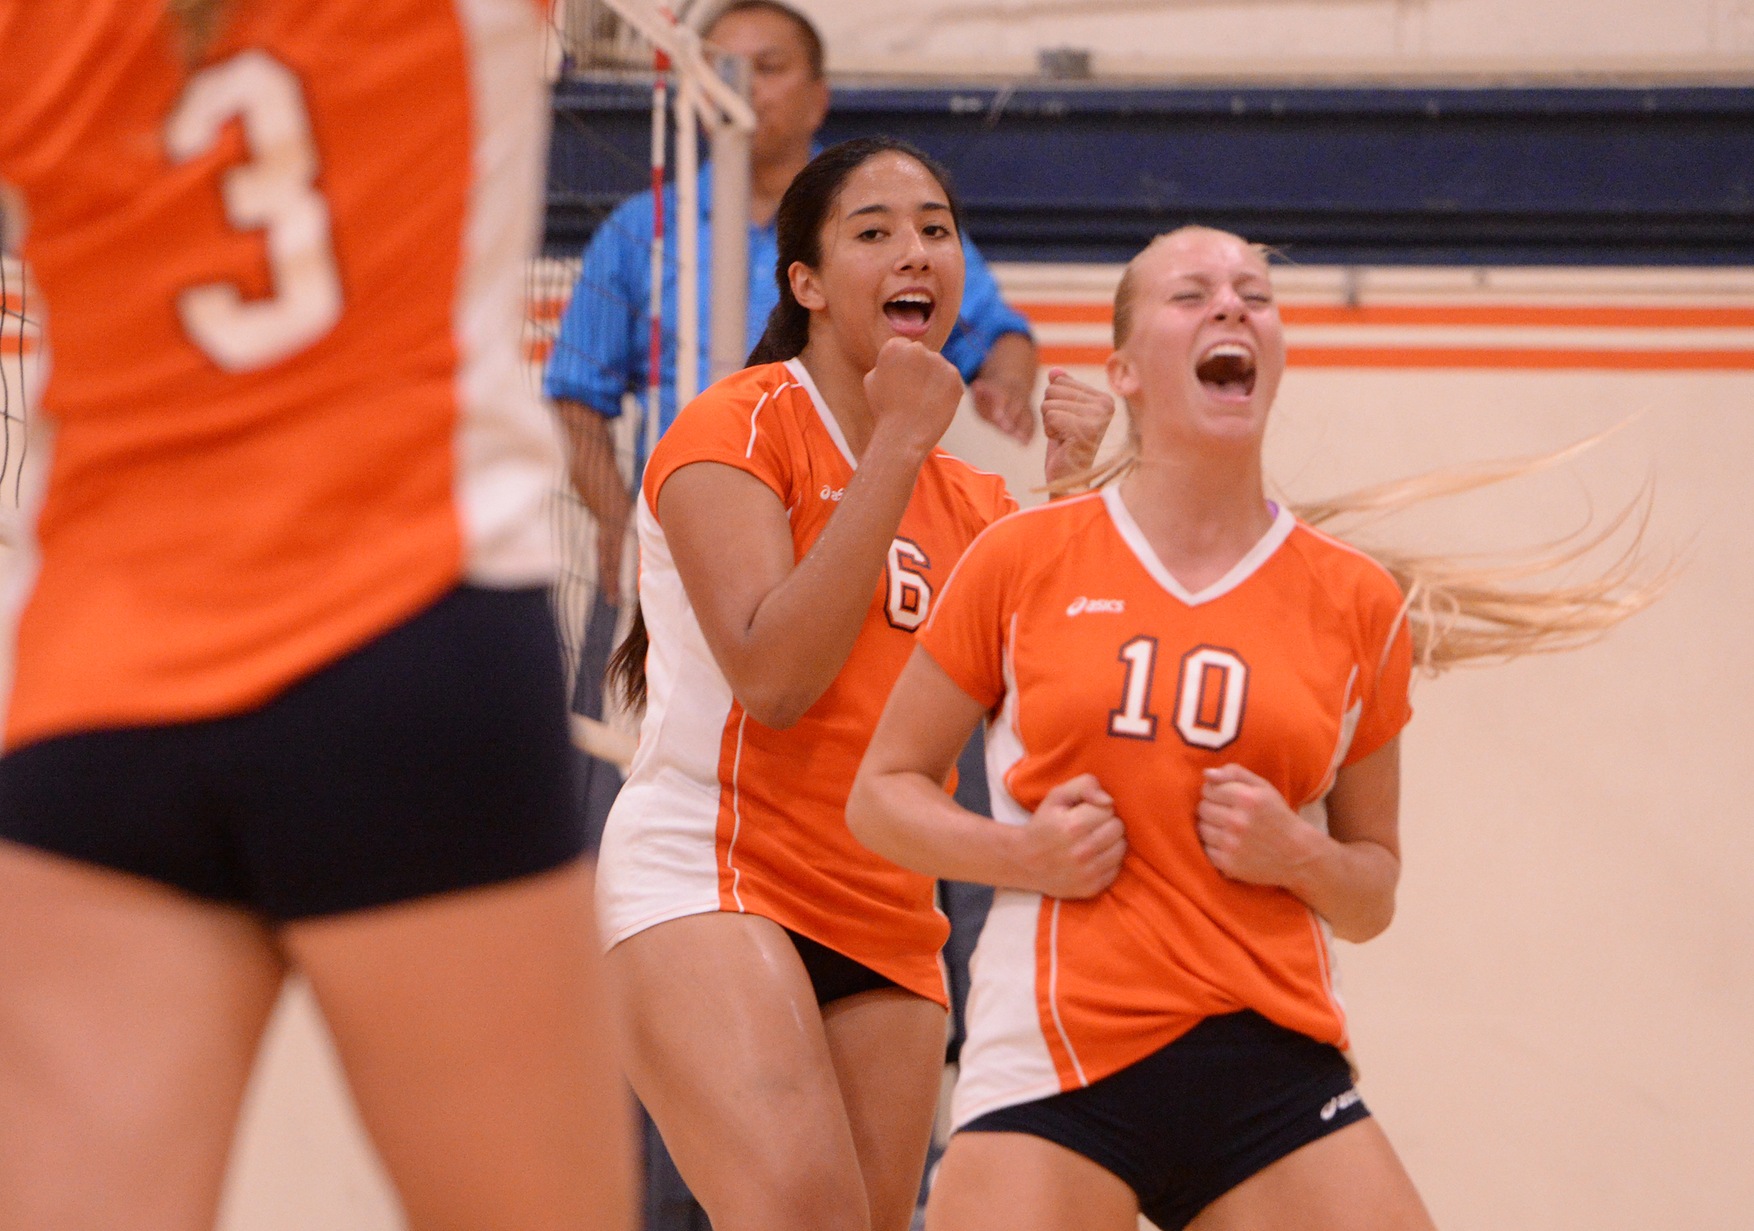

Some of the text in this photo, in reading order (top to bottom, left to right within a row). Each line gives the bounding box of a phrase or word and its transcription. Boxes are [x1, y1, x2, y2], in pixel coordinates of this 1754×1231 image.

[165, 47, 346, 374] 3
[884, 534, 933, 634] 6
[1107, 634, 1251, 752] 10
